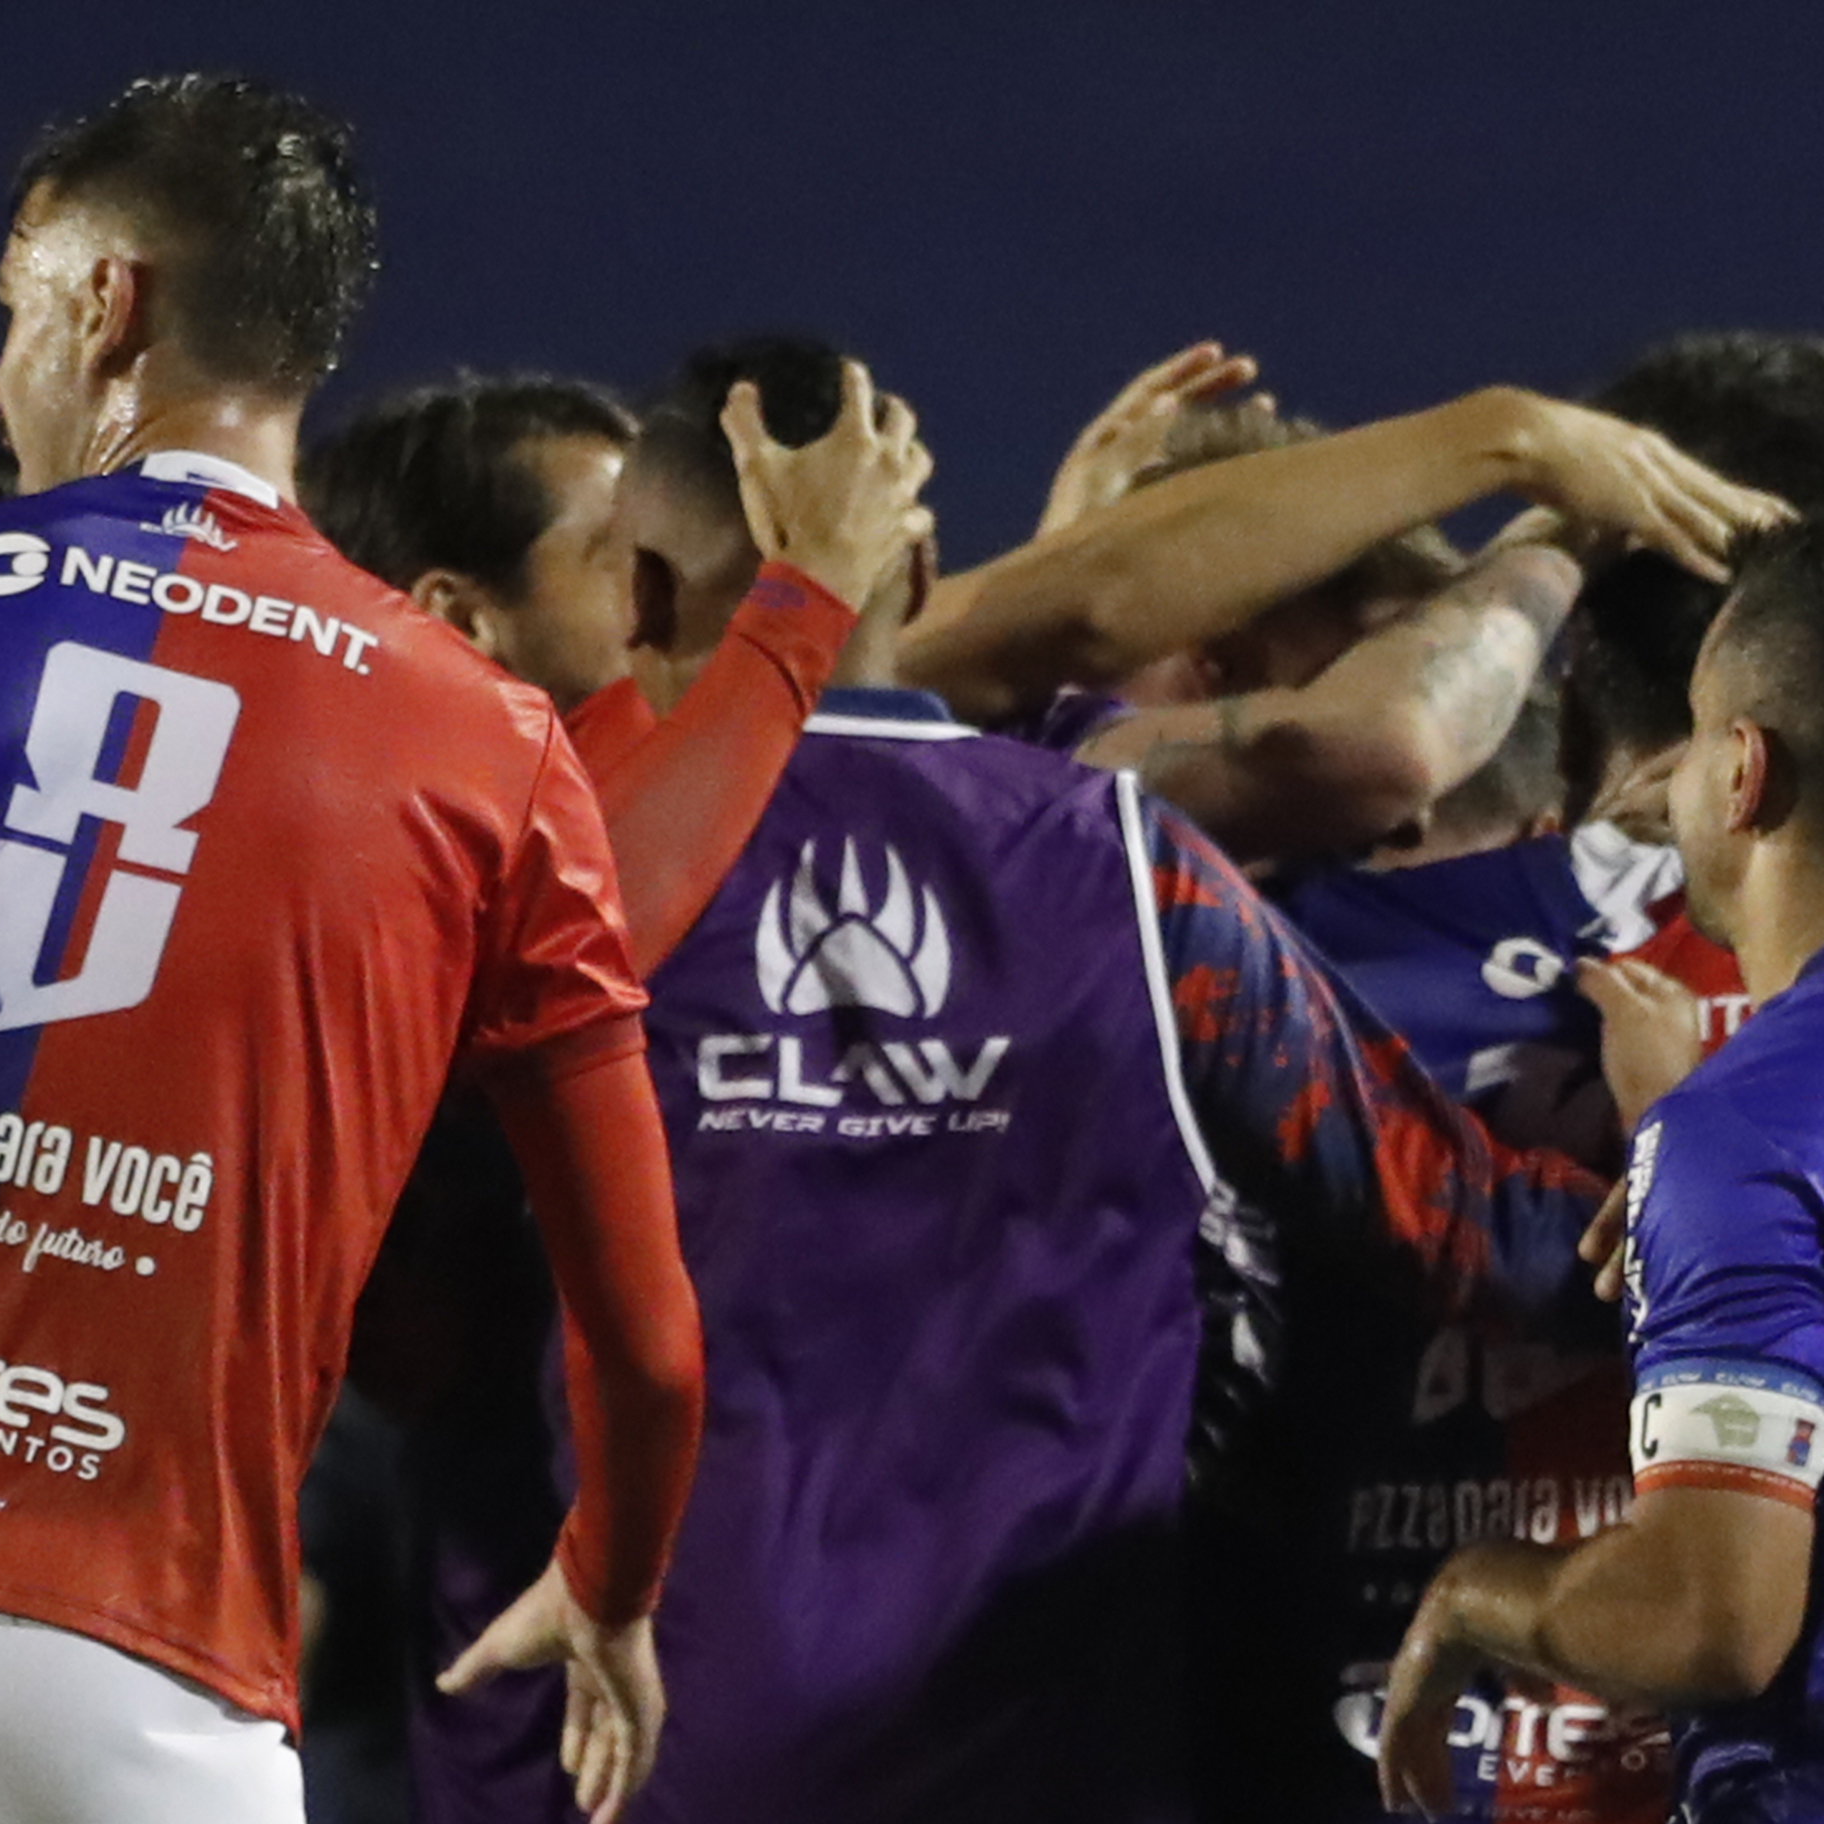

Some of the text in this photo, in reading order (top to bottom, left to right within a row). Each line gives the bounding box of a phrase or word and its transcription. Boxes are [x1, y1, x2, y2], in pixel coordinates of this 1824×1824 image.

[697, 1033, 1011, 1108] CLAW
[697, 1107, 825, 1134] NEVER
[837, 1114, 937, 1137] GIVE
[82, 1136, 213, 1232] você
